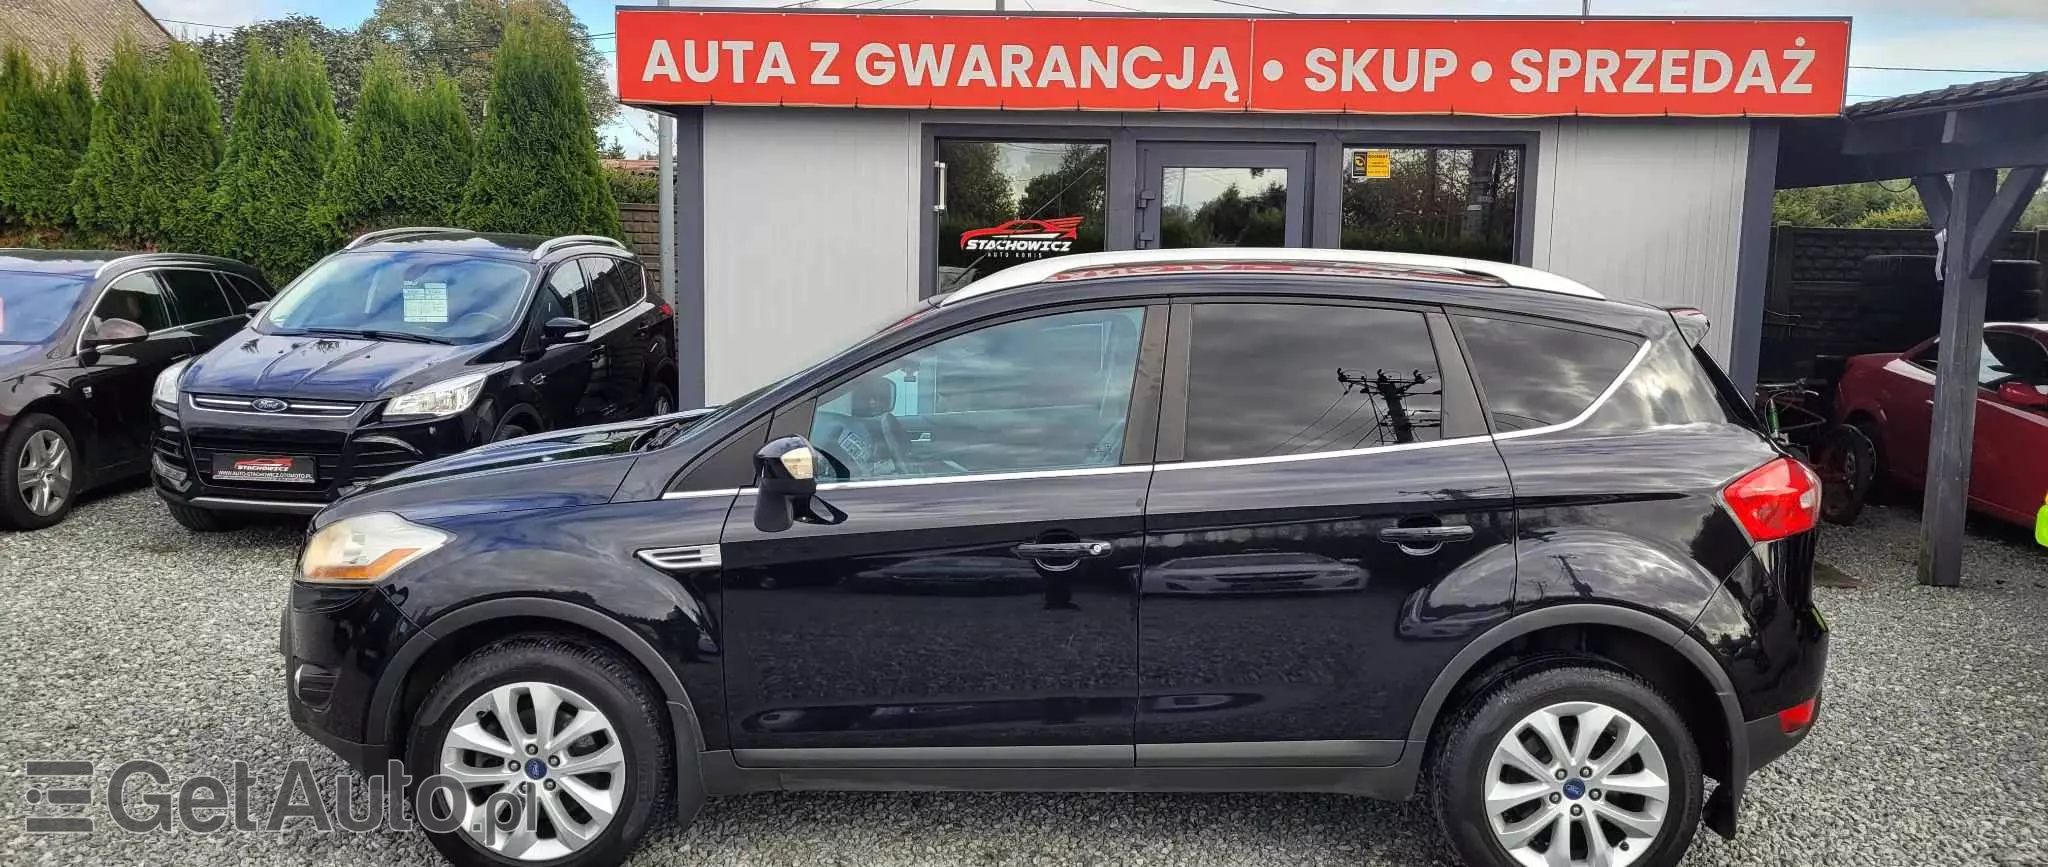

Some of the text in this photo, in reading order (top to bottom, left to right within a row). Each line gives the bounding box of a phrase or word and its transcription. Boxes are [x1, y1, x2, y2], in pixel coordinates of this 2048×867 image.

[642, 36, 1816, 103] AUTA Z GWARANCJĄ SKUP SPRZEDAŻ
[966, 239, 1072, 252] STACHOWICZ
